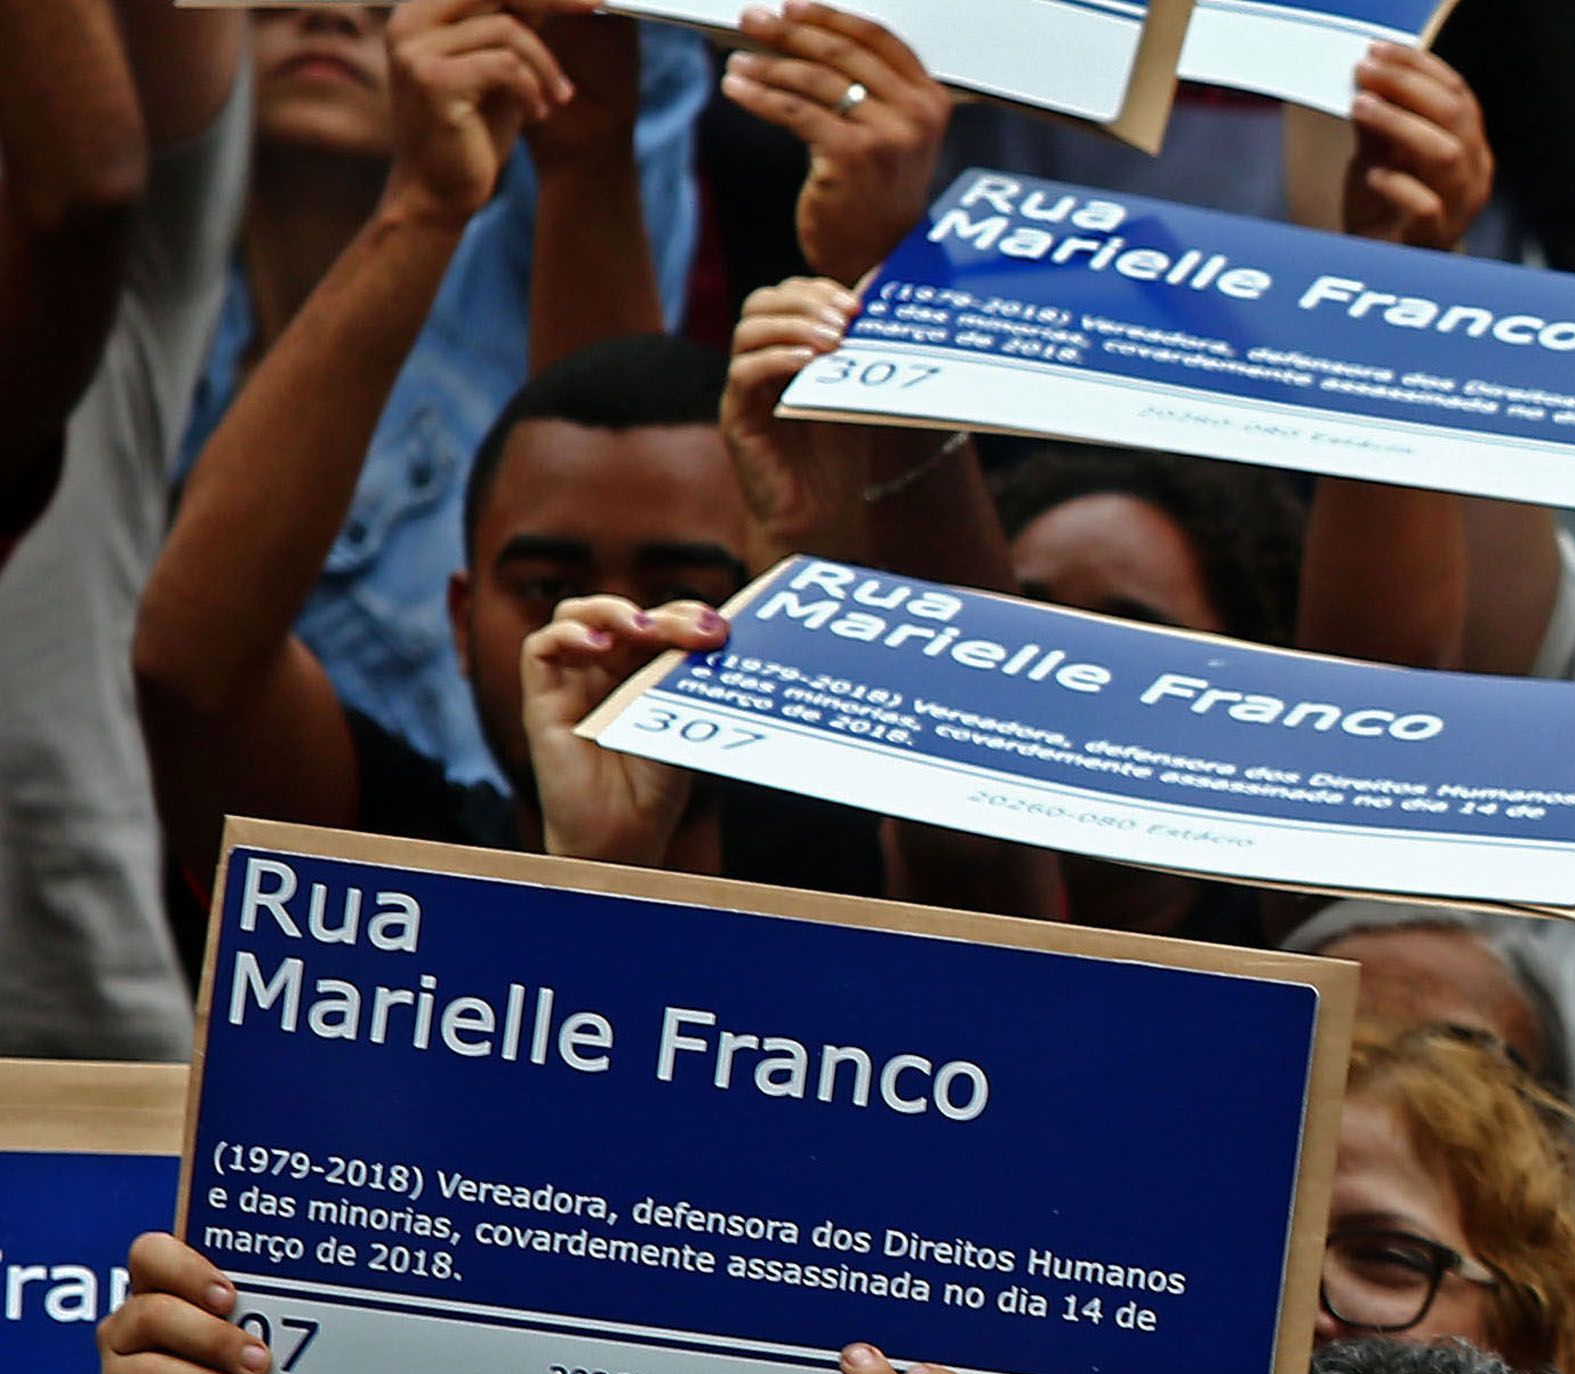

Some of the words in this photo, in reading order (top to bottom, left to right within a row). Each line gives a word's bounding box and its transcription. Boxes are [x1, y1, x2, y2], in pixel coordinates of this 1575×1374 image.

[958, 177, 1125, 232] Rua
[924, 208, 1270, 298] Marielle
[787, 562, 962, 621] Rua
[752, 590, 1111, 691] Marielle
[1140, 674, 1449, 740] Franco
[630, 707, 769, 750] 307
[240, 857, 420, 953] Rua
[228, 950, 613, 1073] Marielle
[656, 1006, 990, 1121] Franco
[201, 1225, 305, 1264] março
[316, 1235, 357, 1267] de
[368, 1242, 463, 1281] 2018.
[206, 1186, 227, 1209] e
[237, 1184, 297, 1218] das
[307, 1197, 462, 1246] minorias,
[475, 1222, 716, 1274] covardemente
[726, 1254, 930, 1303] assassinada
[943, 1283, 985, 1309] no
[996, 1284, 1048, 1317] dia
[1061, 1294, 1104, 1325] 14
[1115, 1300, 1158, 1332] de
[212, 1140, 424, 1201] (1979-2018)
[436, 1170, 618, 1226] Vereadora,
[631, 1196, 799, 1245] defensora
[811, 1220, 872, 1254] dos
[883, 1228, 1016, 1273] Direitos
[1027, 1247, 1188, 1295] Humanos
